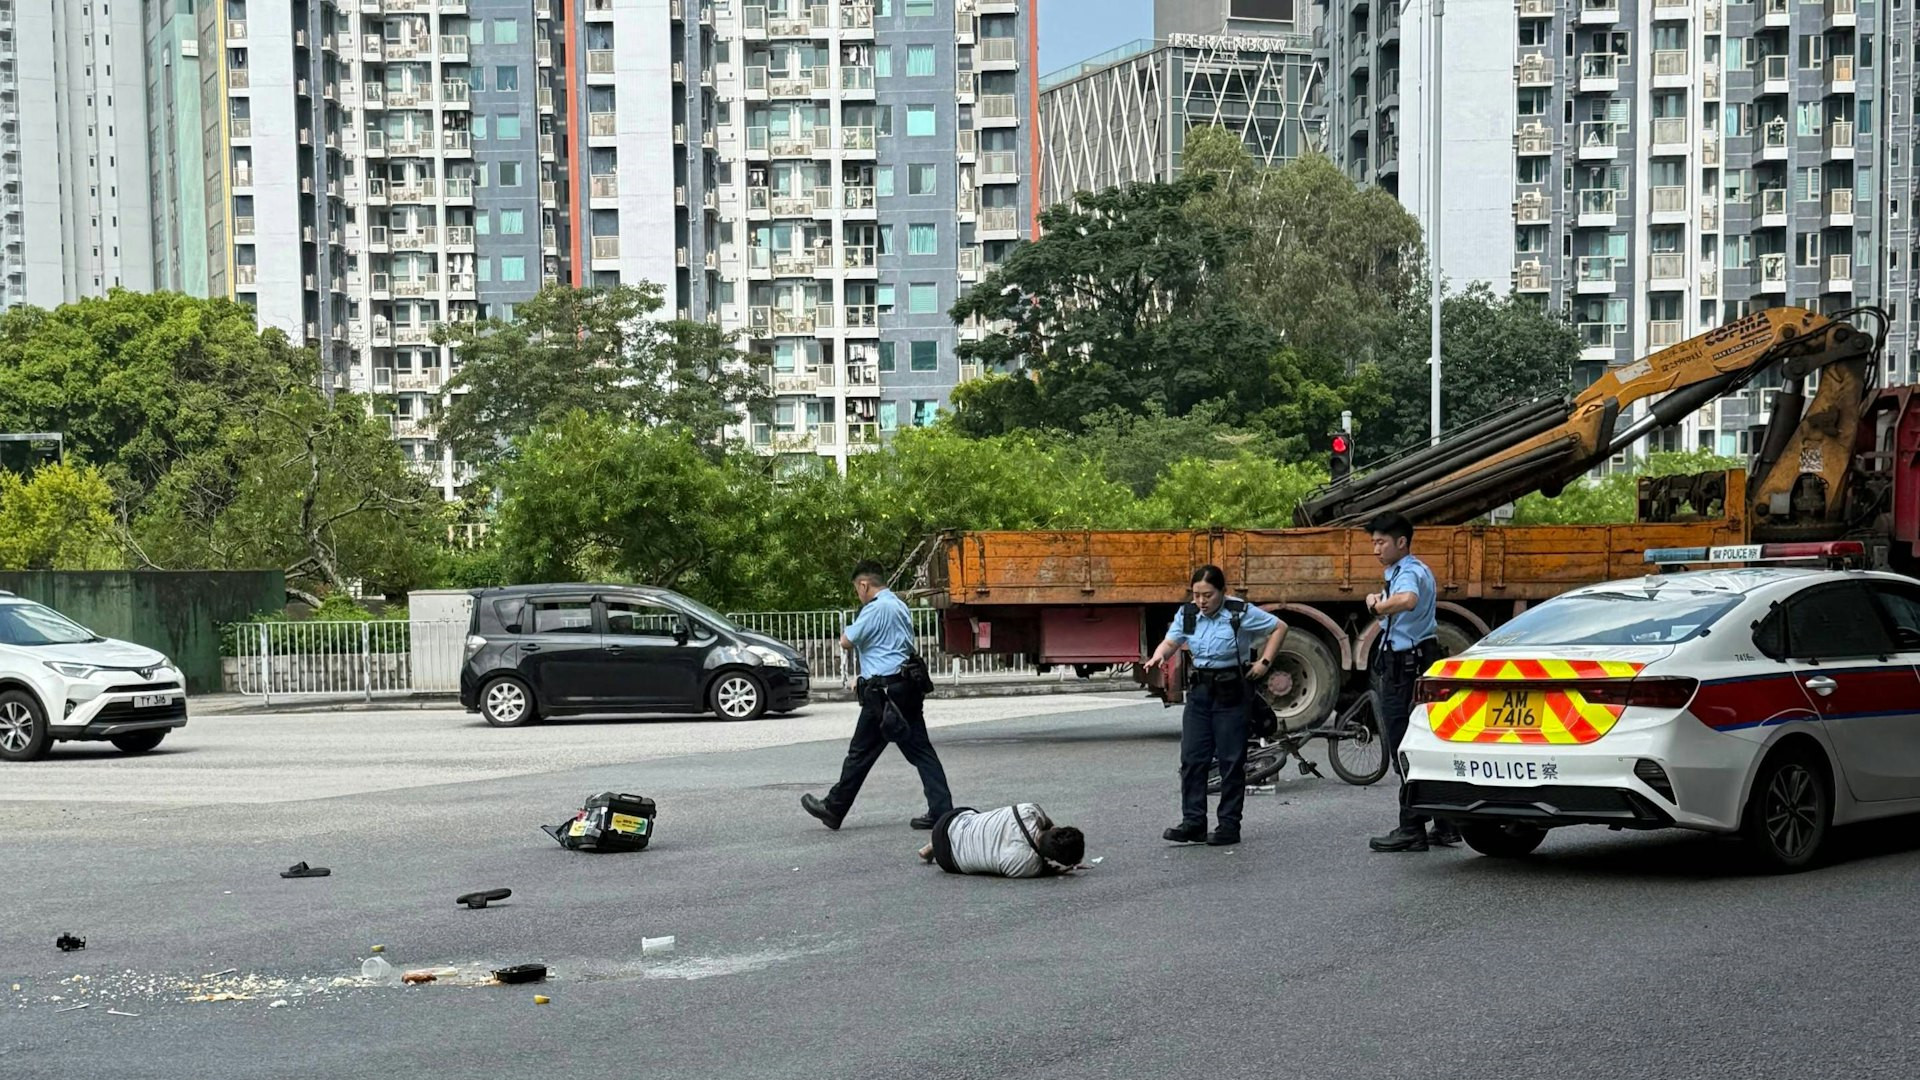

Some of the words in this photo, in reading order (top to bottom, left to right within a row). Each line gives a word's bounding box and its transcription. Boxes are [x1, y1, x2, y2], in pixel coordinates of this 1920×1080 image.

[1722, 548, 1748, 560] POLICE
[1503, 690, 1528, 708] AM
[1492, 708, 1536, 726] 7416
[1453, 759, 1467, 777] 警
[1470, 760, 1538, 780] POLICE
[1541, 762, 1558, 780] 察
